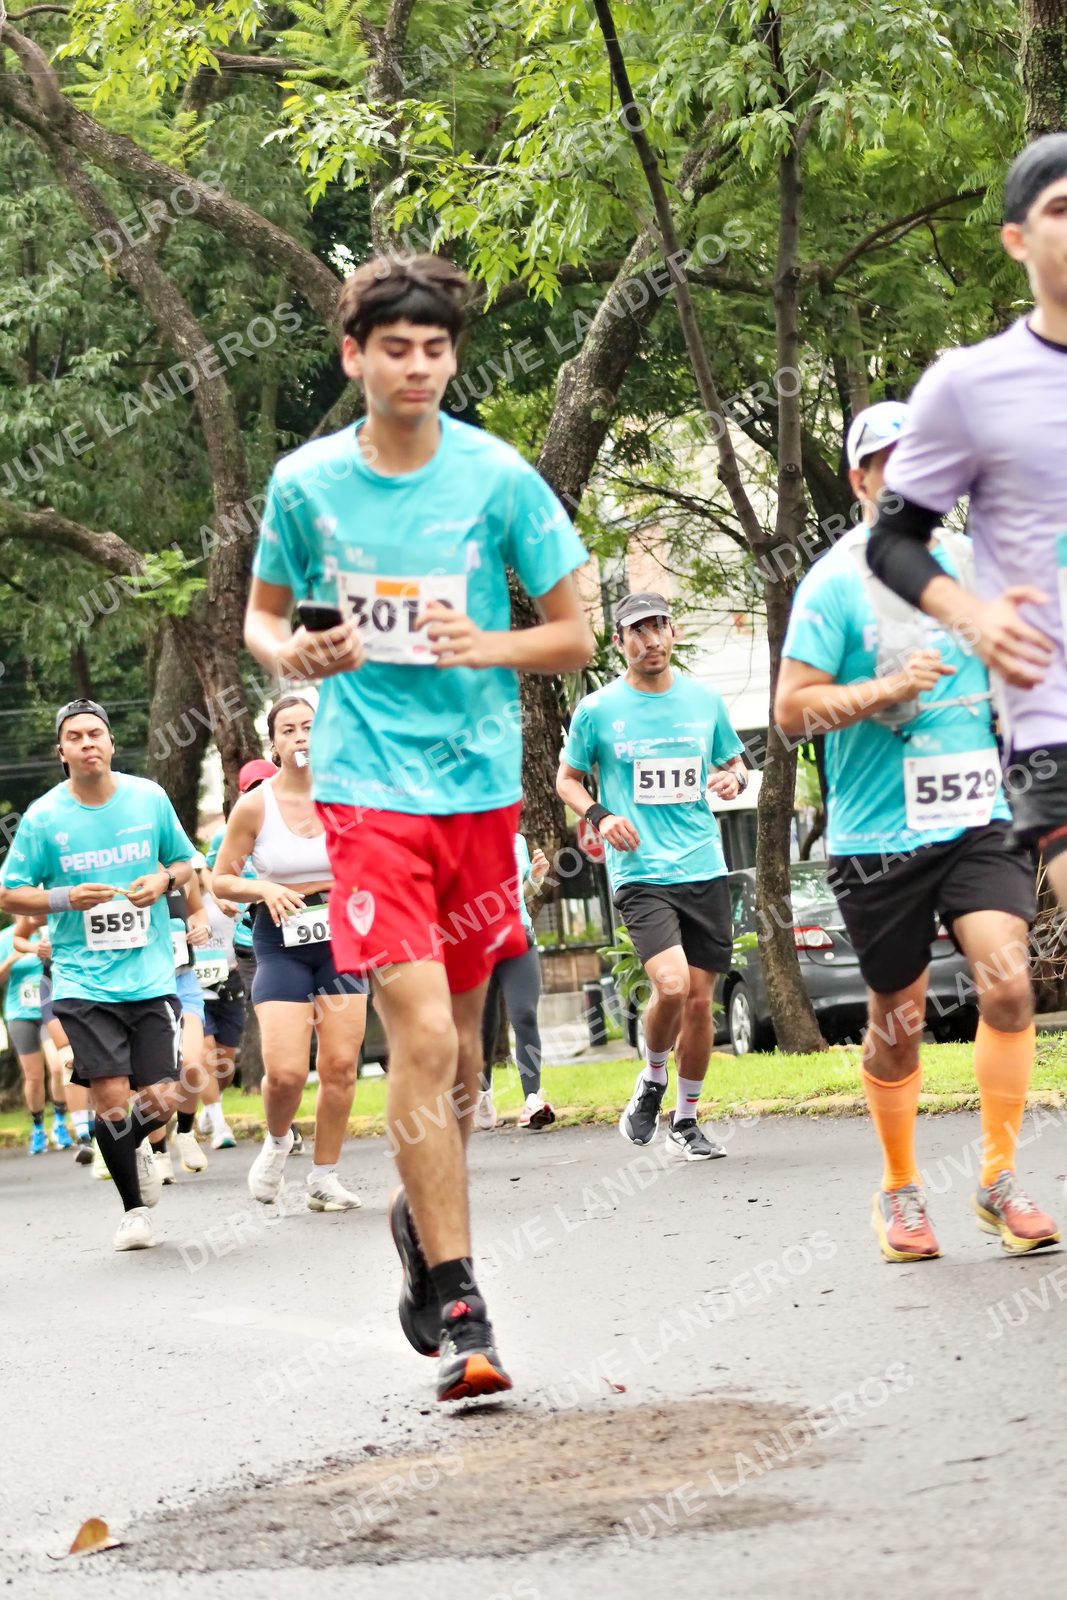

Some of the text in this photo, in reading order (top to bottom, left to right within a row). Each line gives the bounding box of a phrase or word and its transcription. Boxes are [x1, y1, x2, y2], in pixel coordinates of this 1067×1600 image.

[638, 768, 697, 789] 5118
[915, 768, 997, 805] 5529
[59, 840, 151, 873] PERDURA
[90, 911, 146, 935] 5591
[296, 920, 332, 943] 90
